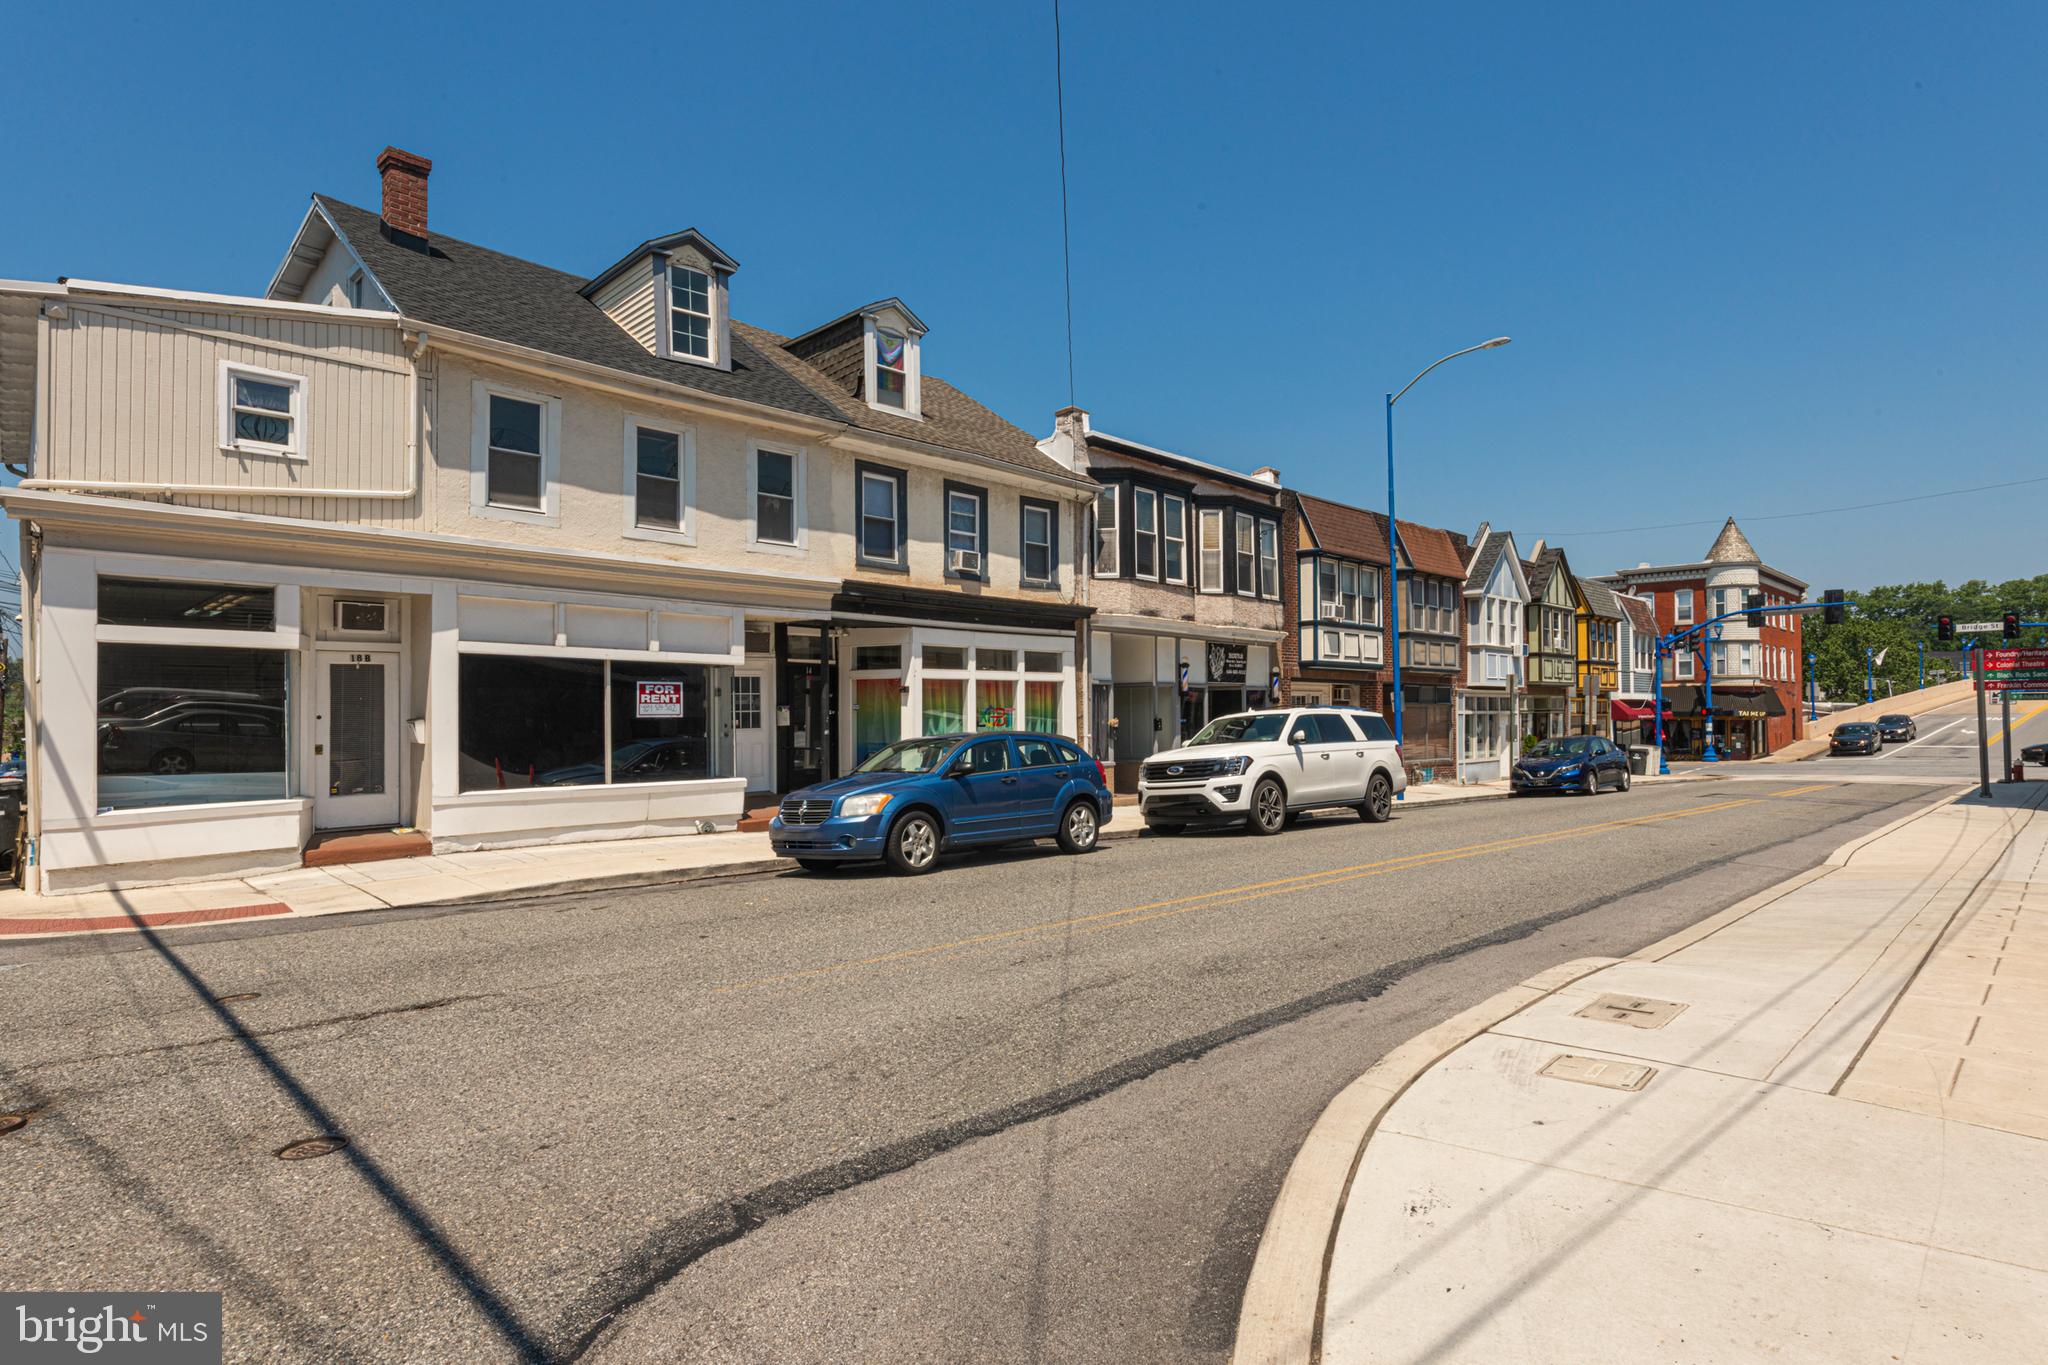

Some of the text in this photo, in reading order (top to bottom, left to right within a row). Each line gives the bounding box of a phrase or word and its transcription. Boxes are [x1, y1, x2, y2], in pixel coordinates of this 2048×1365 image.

[1996, 661, 2020, 669] Colonial
[645, 685, 674, 694] FOR
[641, 694, 679, 703] RENT
